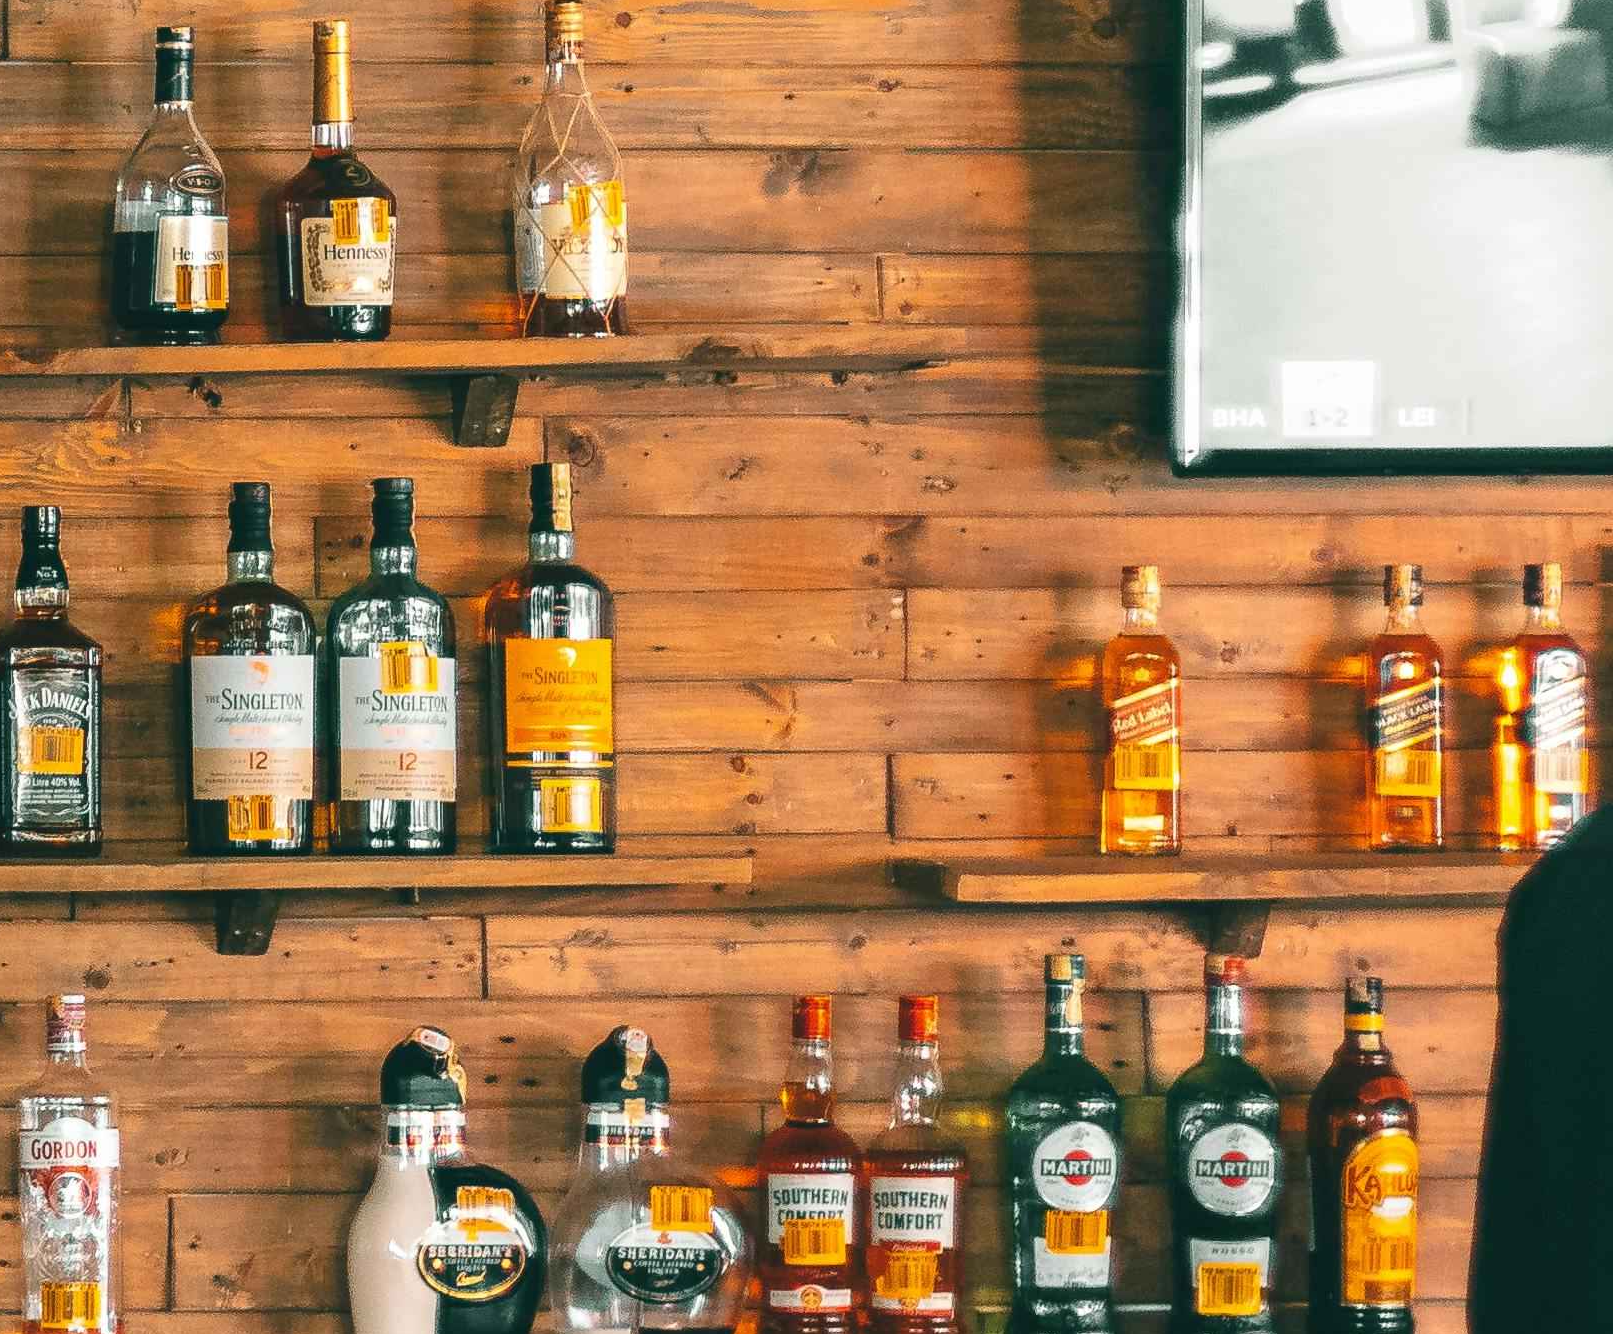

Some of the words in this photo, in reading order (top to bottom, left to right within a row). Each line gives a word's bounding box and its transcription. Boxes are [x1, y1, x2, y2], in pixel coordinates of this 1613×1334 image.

[325, 245, 388, 261] Hennessy
[221, 688, 303, 710] SINGLETON
[373, 689, 449, 712] SINGLETON
[249, 751, 268, 770] 12
[399, 752, 418, 771] 12
[31, 1139, 98, 1160] GORDON
[1042, 1159, 1111, 1176] MARTINI
[1197, 1160, 1269, 1178] MARTINI
[773, 1188, 849, 1207] SOUTHERN
[874, 1190, 949, 1210] SOUTHERN
[877, 1214, 943, 1231] COMFORT
[617, 1246, 706, 1261] SHERIDAN'S
